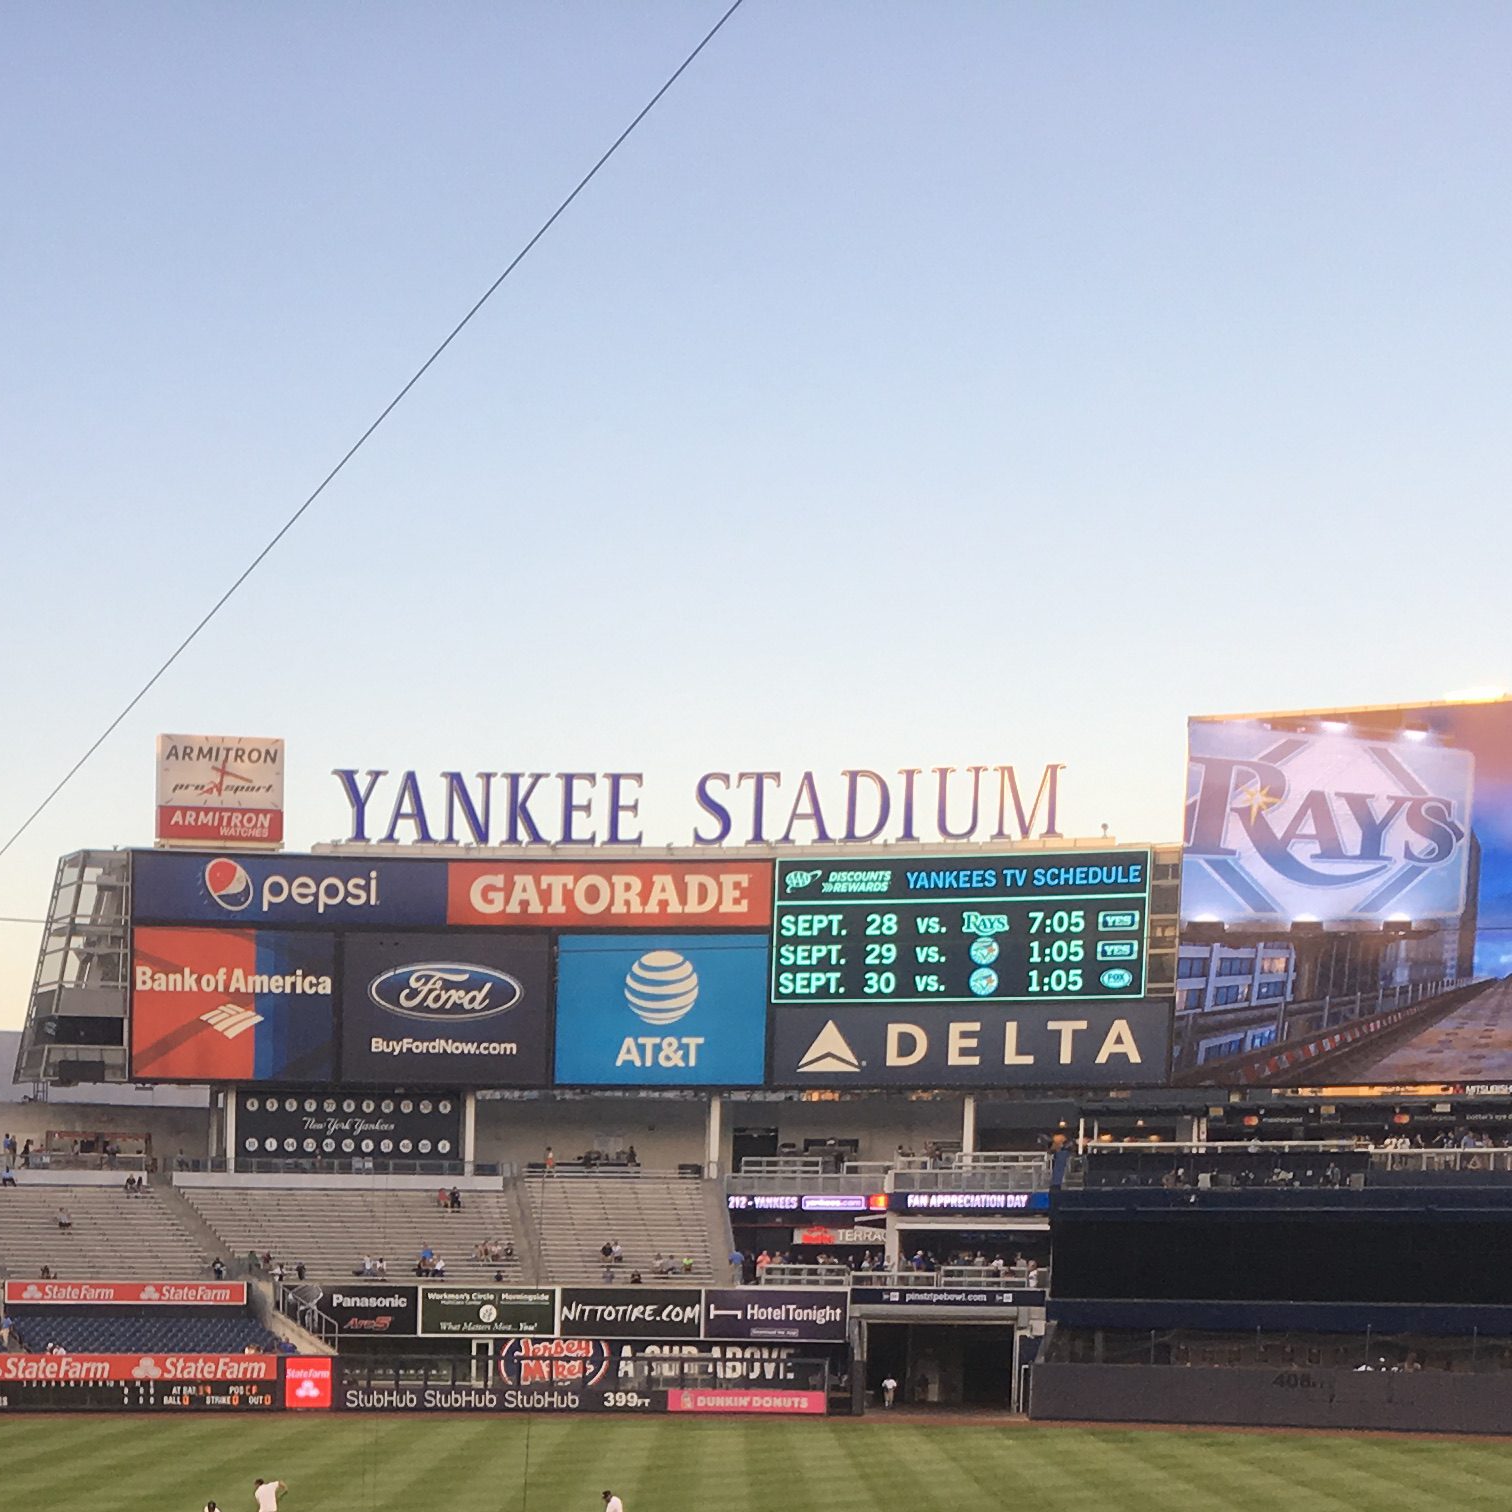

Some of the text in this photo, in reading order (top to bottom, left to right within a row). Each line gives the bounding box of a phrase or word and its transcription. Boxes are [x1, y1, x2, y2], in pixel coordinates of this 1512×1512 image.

[166, 745, 278, 765] ARMITRON
[332, 764, 1067, 846] YANKEE STADIUM
[170, 810, 271, 828] ARMITRON
[220, 826, 268, 837] WATCHES
[829, 871, 892, 883] DISCOUNTS
[906, 865, 1143, 889] YANKEES TV SCHEDULE
[262, 870, 377, 913] pepsi
[470, 873, 749, 915] GATORADE
[832, 881, 889, 893] REWARDS
[780, 914, 848, 937] SEPT.
[865, 913, 898, 936] 28
[1028, 910, 1085, 934] 7:05
[1105, 915, 1132, 927] YES
[779, 942, 846, 966] SEPT.
[864, 942, 897, 965] 29
[1029, 940, 1084, 963] 1:05
[1103, 944, 1131, 956] YES
[135, 966, 332, 994] Bank of America
[778, 972, 846, 994] SEPT.
[863, 972, 896, 994] 30
[1028, 970, 1083, 992] 1:05
[399, 970, 489, 1011] Ford
[371, 1038, 517, 1056] BuyFordNow.com
[615, 1037, 704, 1067] AT&T
[886, 1019, 1142, 1067] DELTA
[302, 1117, 395, 1135] New York Yankees
[754, 1196, 798, 1209] YANKEES
[907, 1194, 1028, 1208] FAN APPRECIATION DAY
[332, 1293, 407, 1308] Panasonic
[905, 1292, 987, 1303] pinstripebowl.com
[561, 1302, 700, 1325] NITTOTIRE.COM
[440, 1321, 461, 1331] What
[172, 1386, 181, 1395] AT
[346, 1390, 579, 1408] StubHub StubHub StubHub
[248, 1396, 263, 1405] OUT
[697, 1396, 809, 1409] DUNKIN' DONUTS
